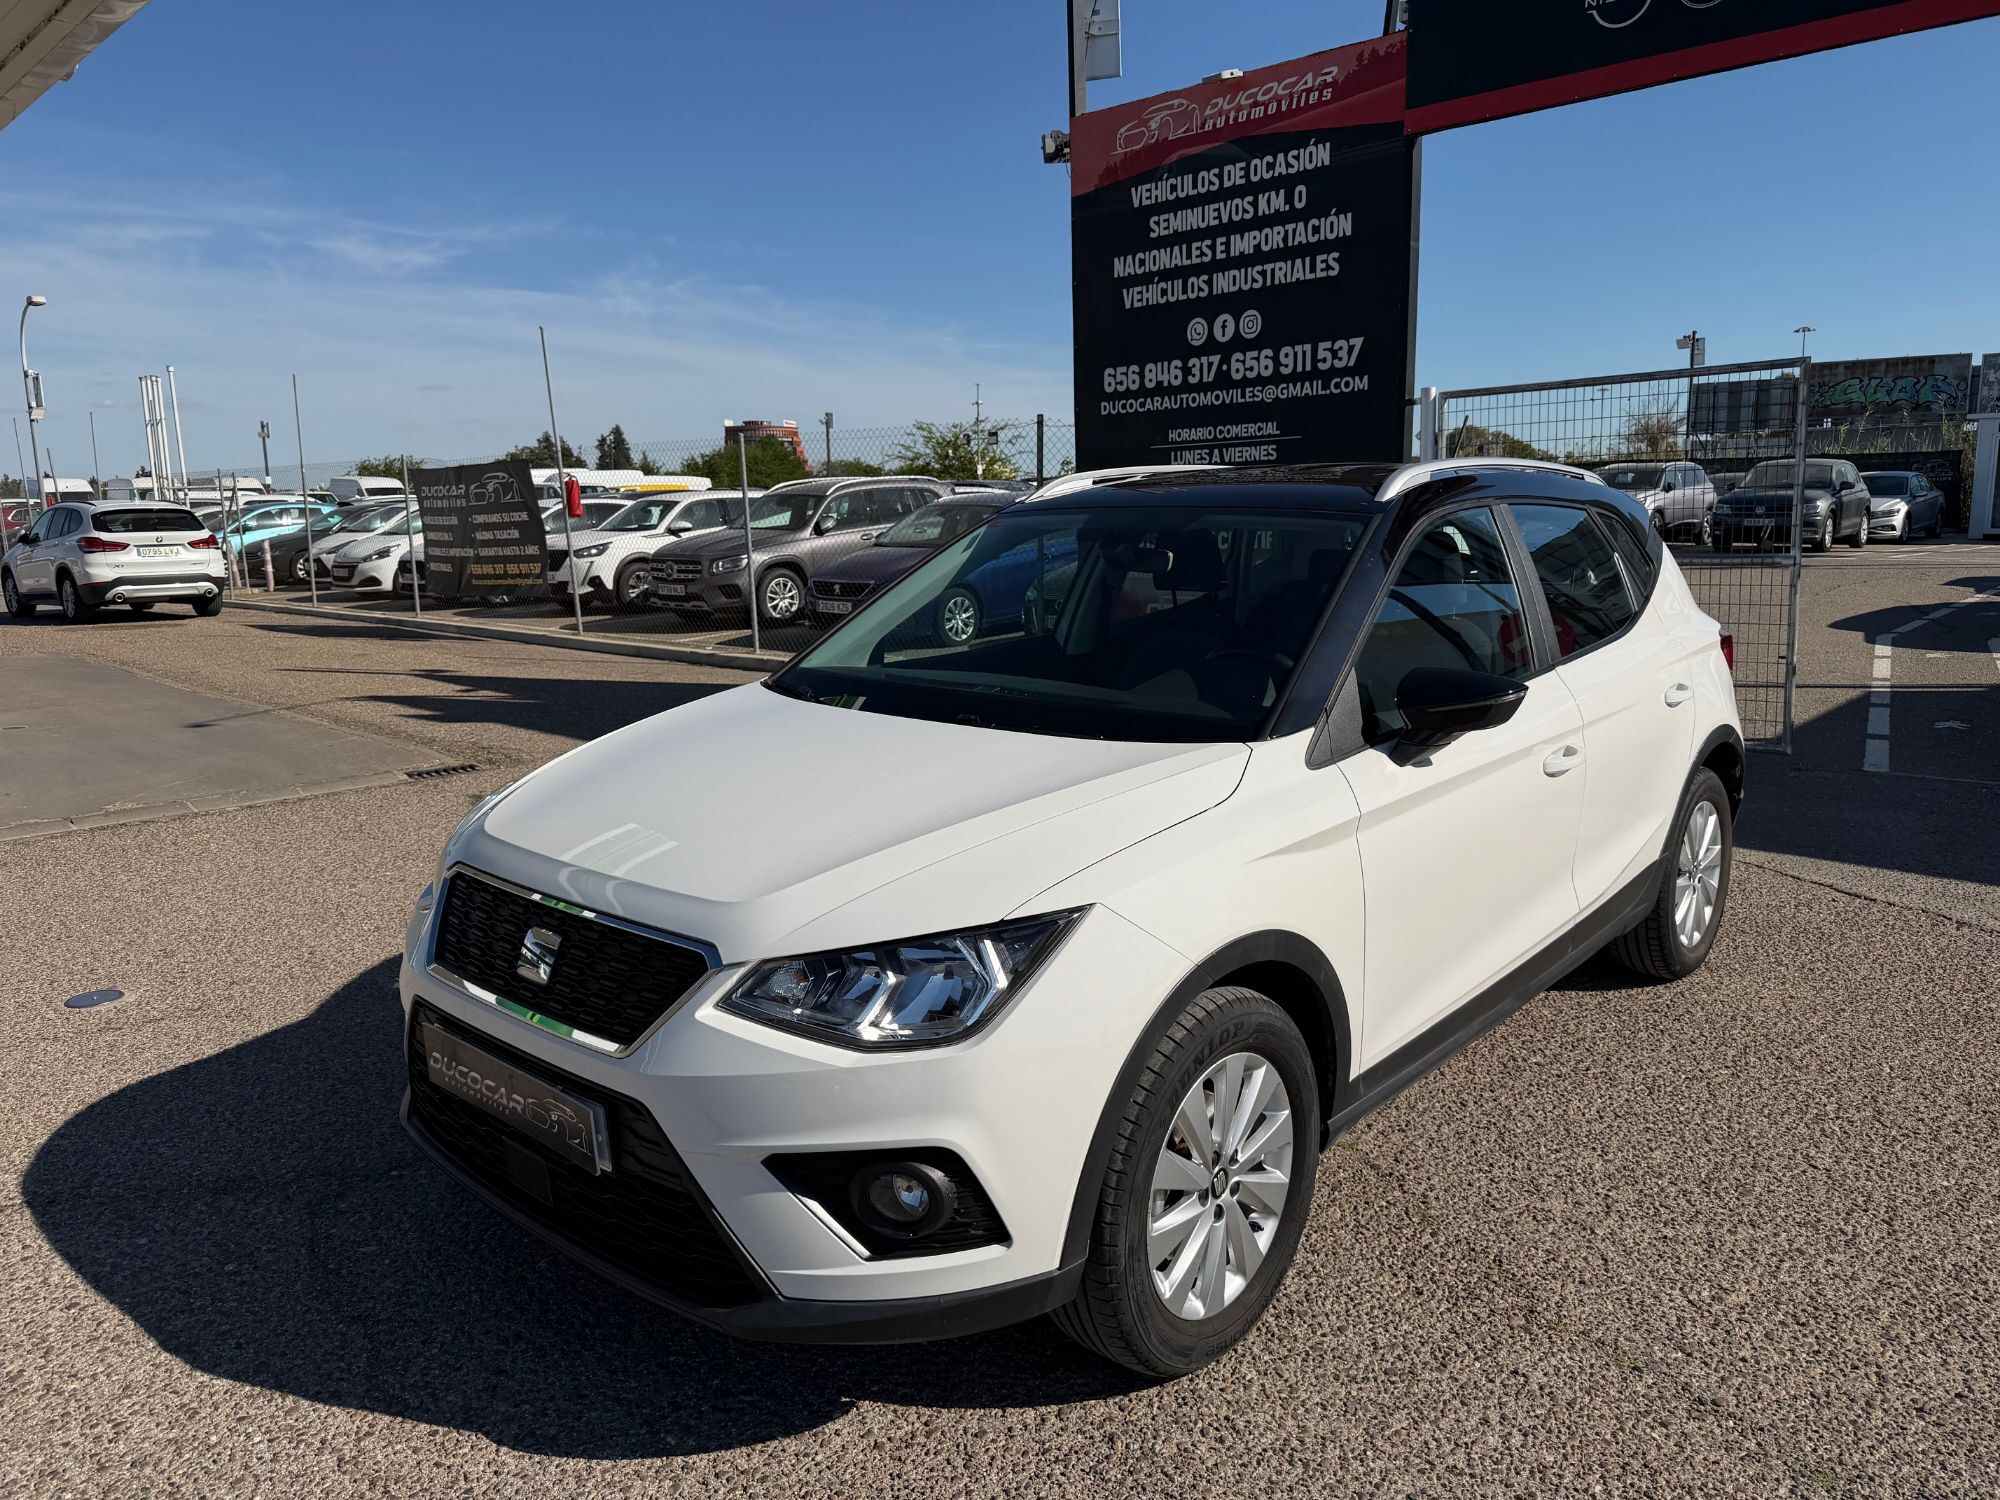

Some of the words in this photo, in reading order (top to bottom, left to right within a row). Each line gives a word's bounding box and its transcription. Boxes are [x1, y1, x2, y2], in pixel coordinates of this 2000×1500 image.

[1204, 65, 1338, 116] DUCOCAR
[1131, 168, 1220, 208] VEHÍCULOS
[1223, 163, 1246, 188] DE
[1249, 138, 1331, 183] OCASIÓN
[1149, 195, 1254, 238] SEMINUEVOS
[1257, 189, 1290, 217] KM.
[1113, 239, 1212, 278] NACIONALES
[1215, 236, 1226, 261] E
[1230, 208, 1352, 257] IMPORTACIÓN
[1122, 270, 1209, 309] VEHÍCULOS
[1212, 252, 1340, 294] INDUSTRIALES
[1103, 366, 1141, 393] 656
[1144, 359, 1183, 388] 846
[1279, 343, 1312, 375] 911
[1316, 336, 1365, 370] 537
[1100, 375, 1369, 416] DUCOCARAUTOMOVILES@GMAIL.COM
[1168, 425, 1214, 442] HORARIO
[1216, 421, 1280, 439] COMERCIAL
[1170, 448, 1210, 465] LUNES
[1211, 448, 1221, 464] A
[1222, 445, 1277, 463] VIERNES
[421, 484, 466, 497] DUCOCAR
[142, 547, 162, 556] 0795
[429, 1052, 525, 1114] DUCOCAR
